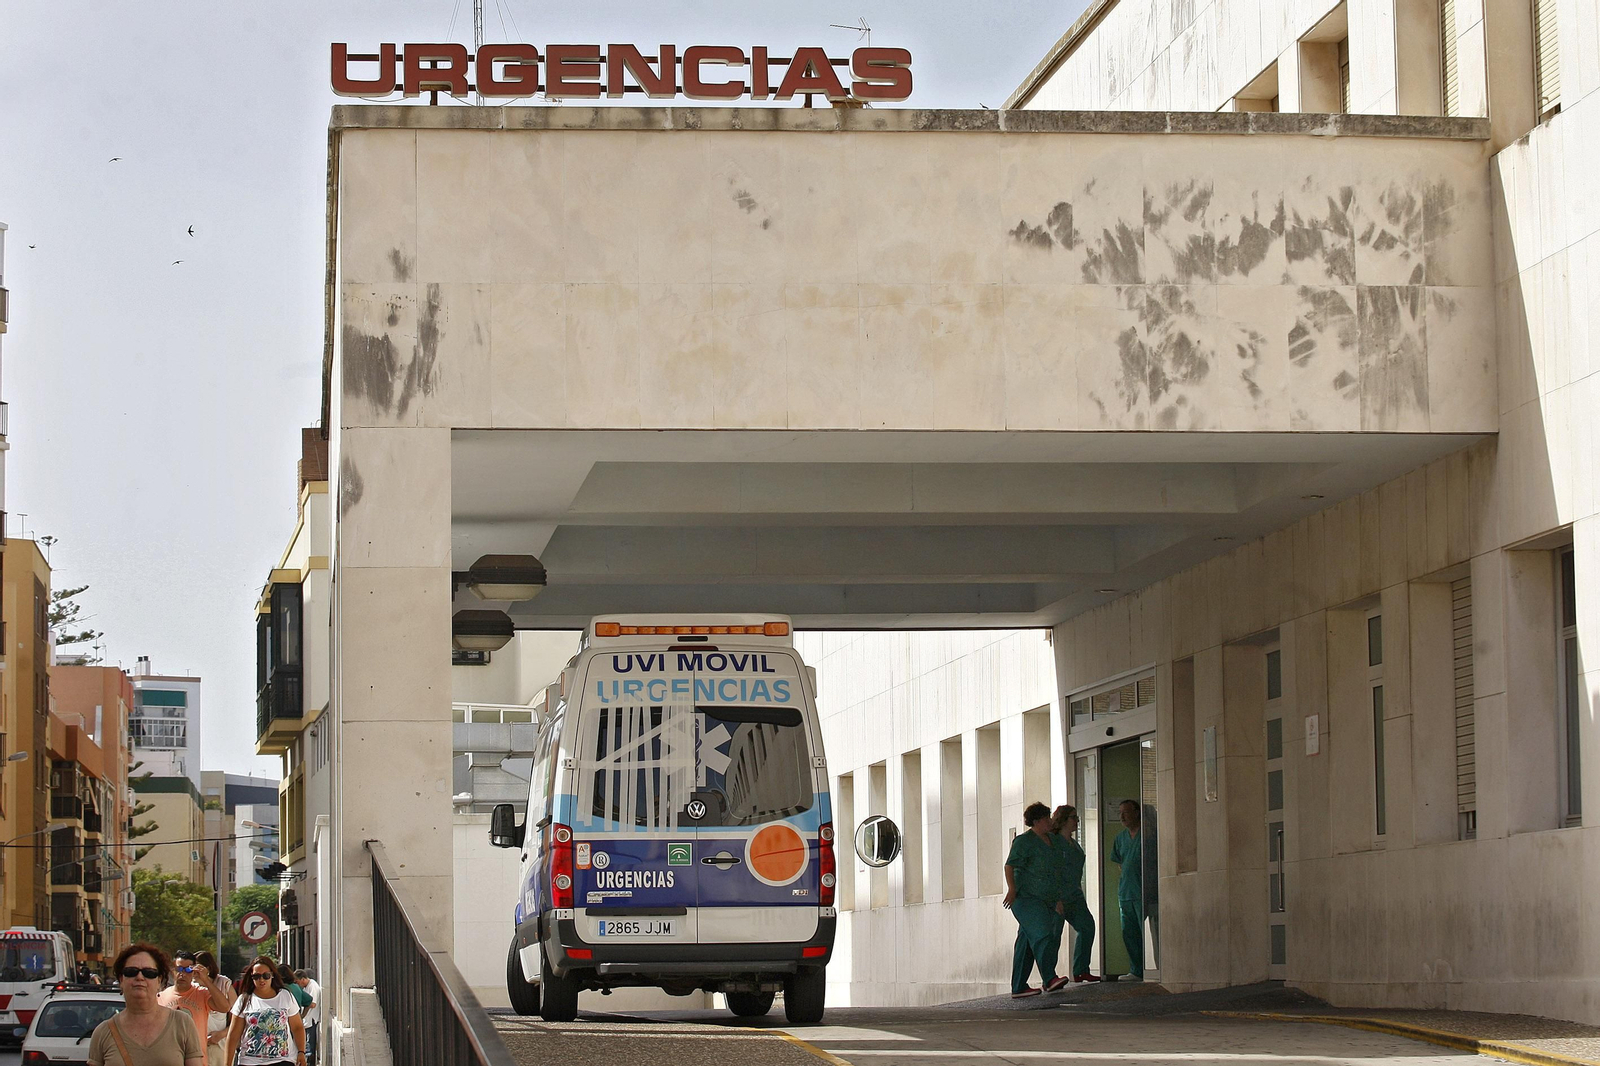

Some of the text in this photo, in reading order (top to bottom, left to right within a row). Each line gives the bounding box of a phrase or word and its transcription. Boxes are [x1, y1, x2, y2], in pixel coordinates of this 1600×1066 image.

[331, 43, 912, 102] URGENCIAS
[613, 653, 776, 673] UVI MOVIL
[597, 678, 791, 704] URGENCIAS
[596, 870, 675, 889] URGENCIAS
[607, 921, 671, 935] 2865 JJM
